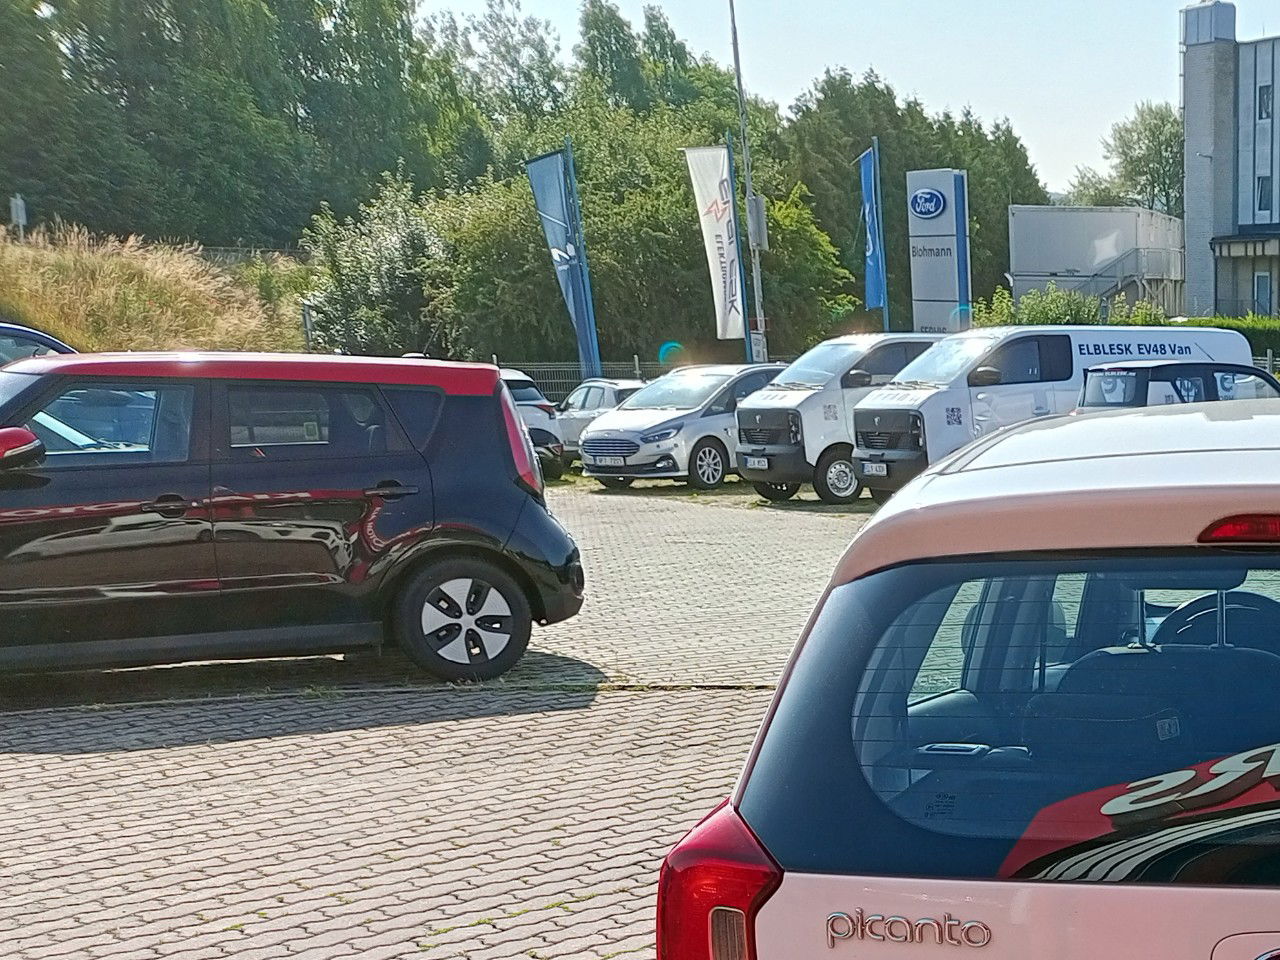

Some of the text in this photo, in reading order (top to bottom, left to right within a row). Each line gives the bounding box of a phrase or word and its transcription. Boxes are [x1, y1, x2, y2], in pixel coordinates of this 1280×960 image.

[915, 192, 938, 213] Ford
[1078, 343, 1192, 356] ELBLESK EV48 Van
[826, 906, 992, 949] picanto
